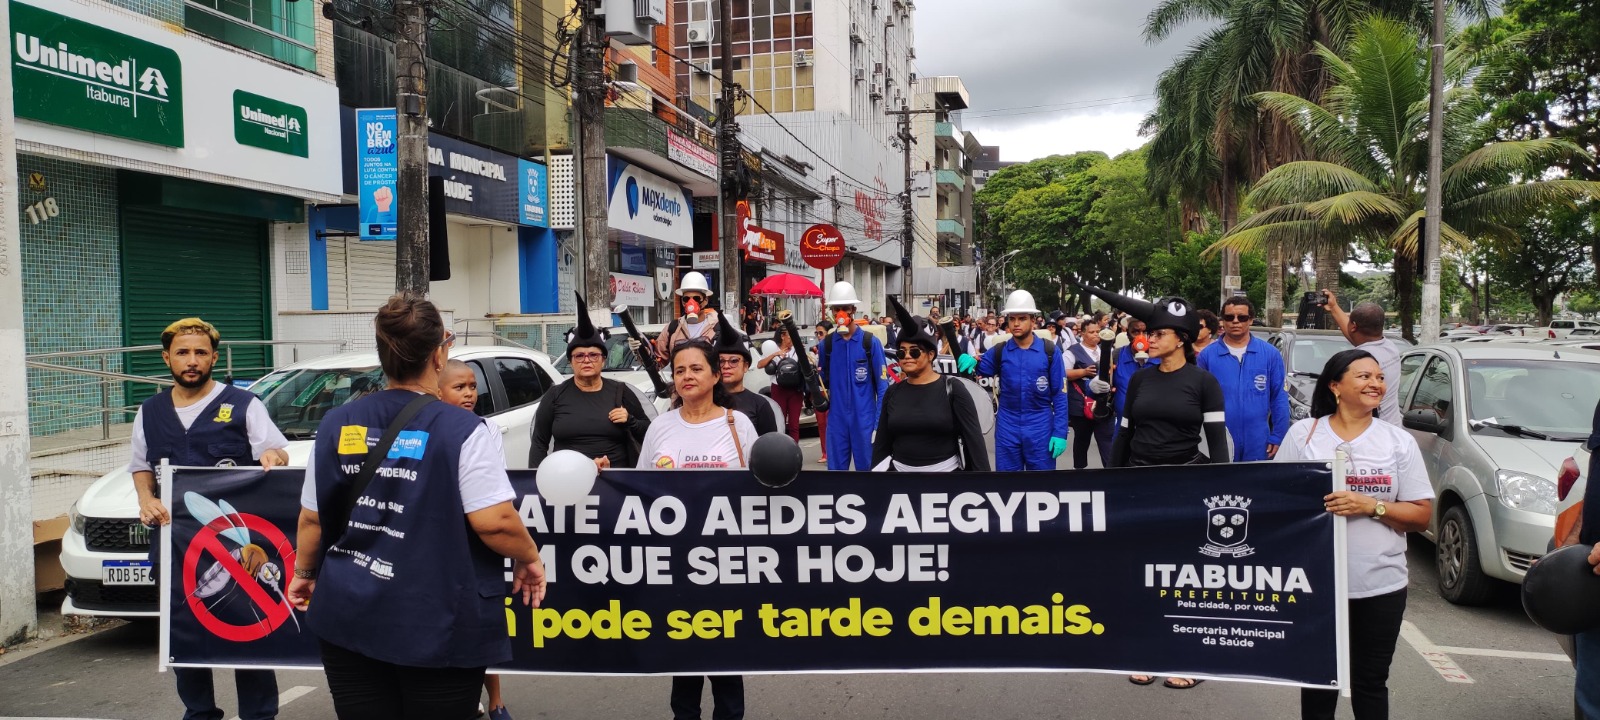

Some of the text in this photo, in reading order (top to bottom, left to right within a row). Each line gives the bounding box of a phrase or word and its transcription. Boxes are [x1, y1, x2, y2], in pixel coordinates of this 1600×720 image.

[16, 32, 130, 86] Unimed
[86, 85, 130, 108] Itabuna
[241, 105, 286, 128] Unimed
[264, 127, 286, 138] Nacional
[366, 122, 384, 131] NO
[367, 130, 392, 139] VEM
[367, 139, 391, 148] BRO
[367, 143, 395, 154] azul
[450, 152, 507, 181] MUNICIPAL
[444, 175, 473, 202] AÚDE
[642, 186, 682, 217] MAXdente
[26, 197, 60, 225] 118
[816, 233, 838, 246] Super
[1346, 476, 1389, 485] OMBATE
[1350, 485, 1391, 493] DENGUE
[519, 491, 1106, 536] ATE AO AEDES AEGYPTI
[571, 544, 673, 585] QUE
[687, 546, 782, 585] SER
[797, 544, 950, 583] HOJE!
[109, 568, 130, 583] RDB
[1145, 564, 1313, 593] ITABUNA
[1160, 590, 1297, 603] PREFEITURA
[1177, 600, 1279, 612] Pela cidade, por você.
[533, 600, 652, 648] pode
[667, 609, 742, 640] ser
[759, 597, 893, 638] tarde
[908, 592, 1105, 636] demais.
[1172, 624, 1285, 640] Secretaria Municipal
[1202, 636, 1254, 647] da Saúde
